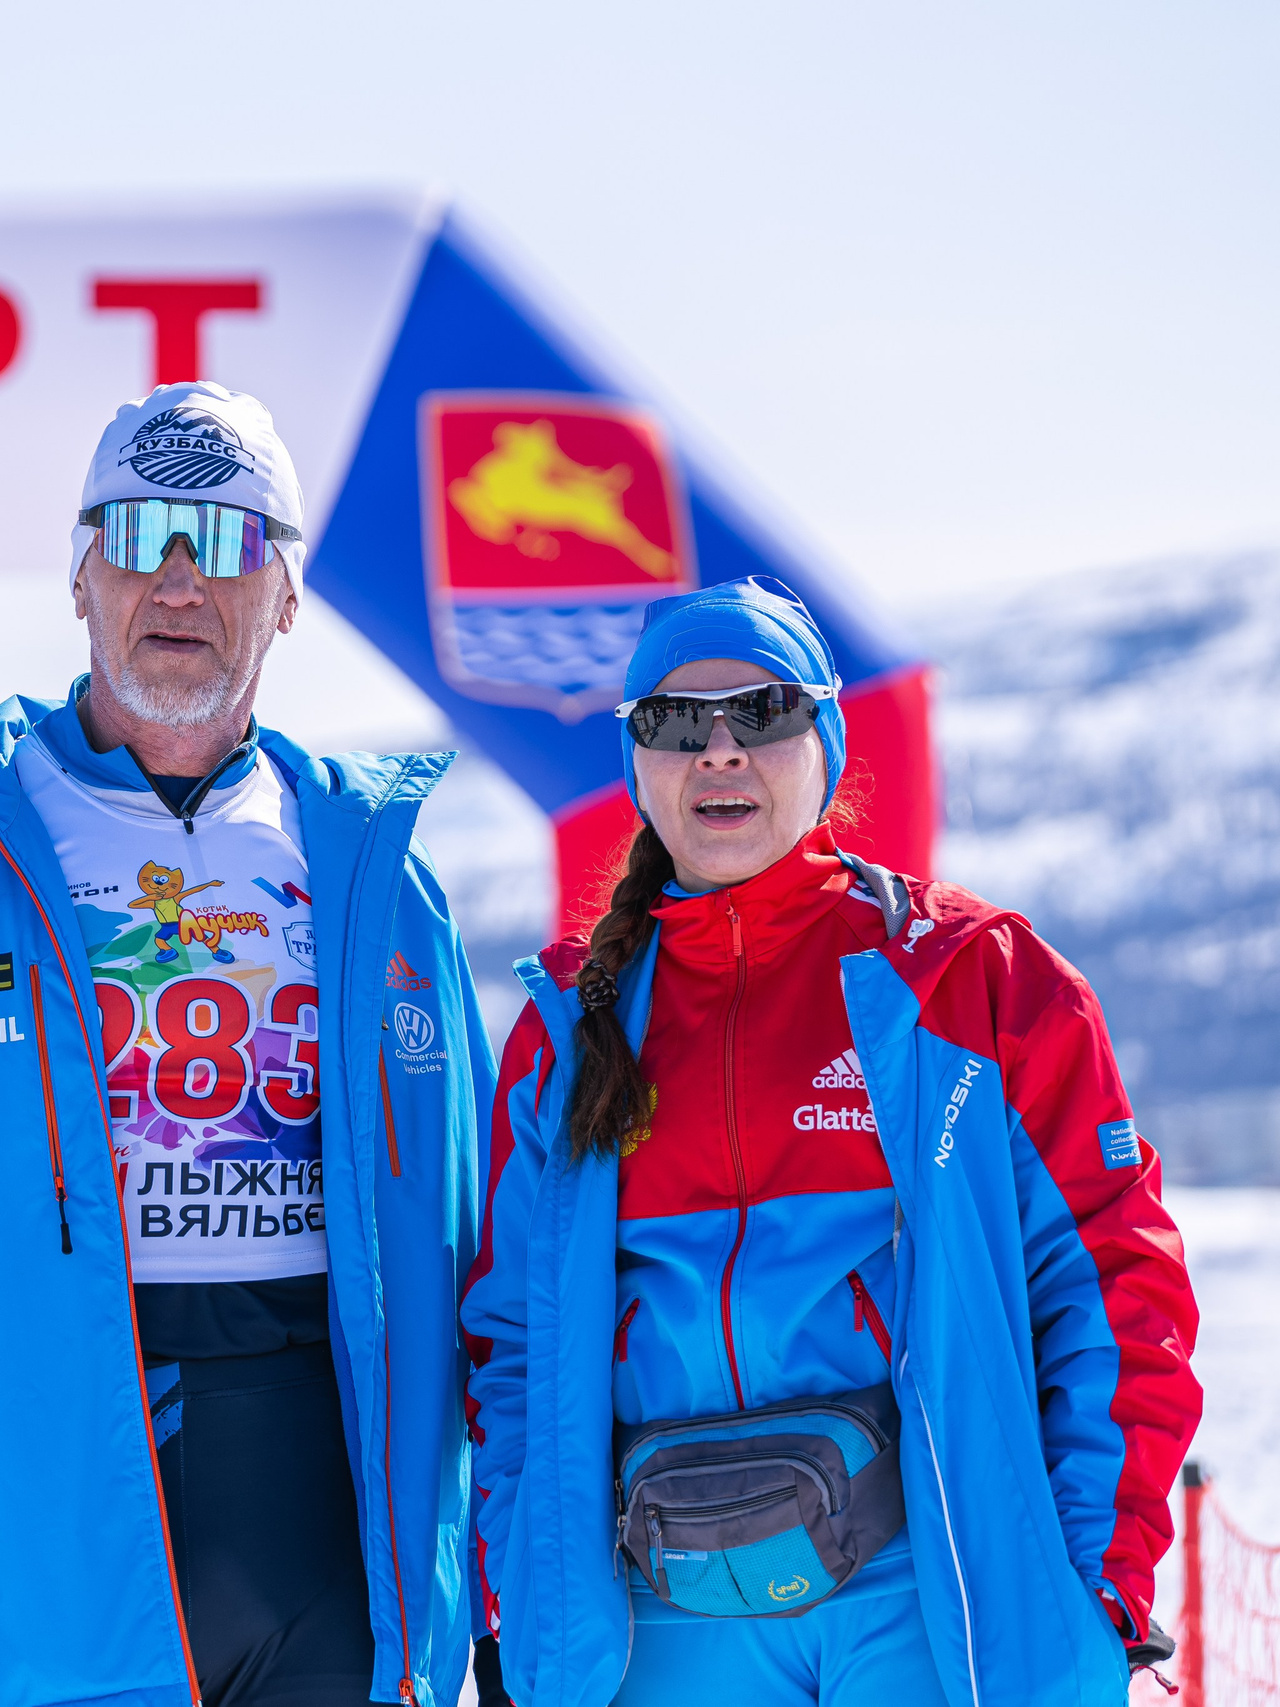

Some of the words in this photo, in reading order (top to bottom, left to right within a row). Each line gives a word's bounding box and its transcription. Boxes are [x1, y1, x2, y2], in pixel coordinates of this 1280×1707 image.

[135, 436, 237, 459] КУЗБАСС
[178, 908, 270, 949] Лучик
[395, 1048, 448, 1062] Commercial
[403, 1062, 442, 1075] Vehicles
